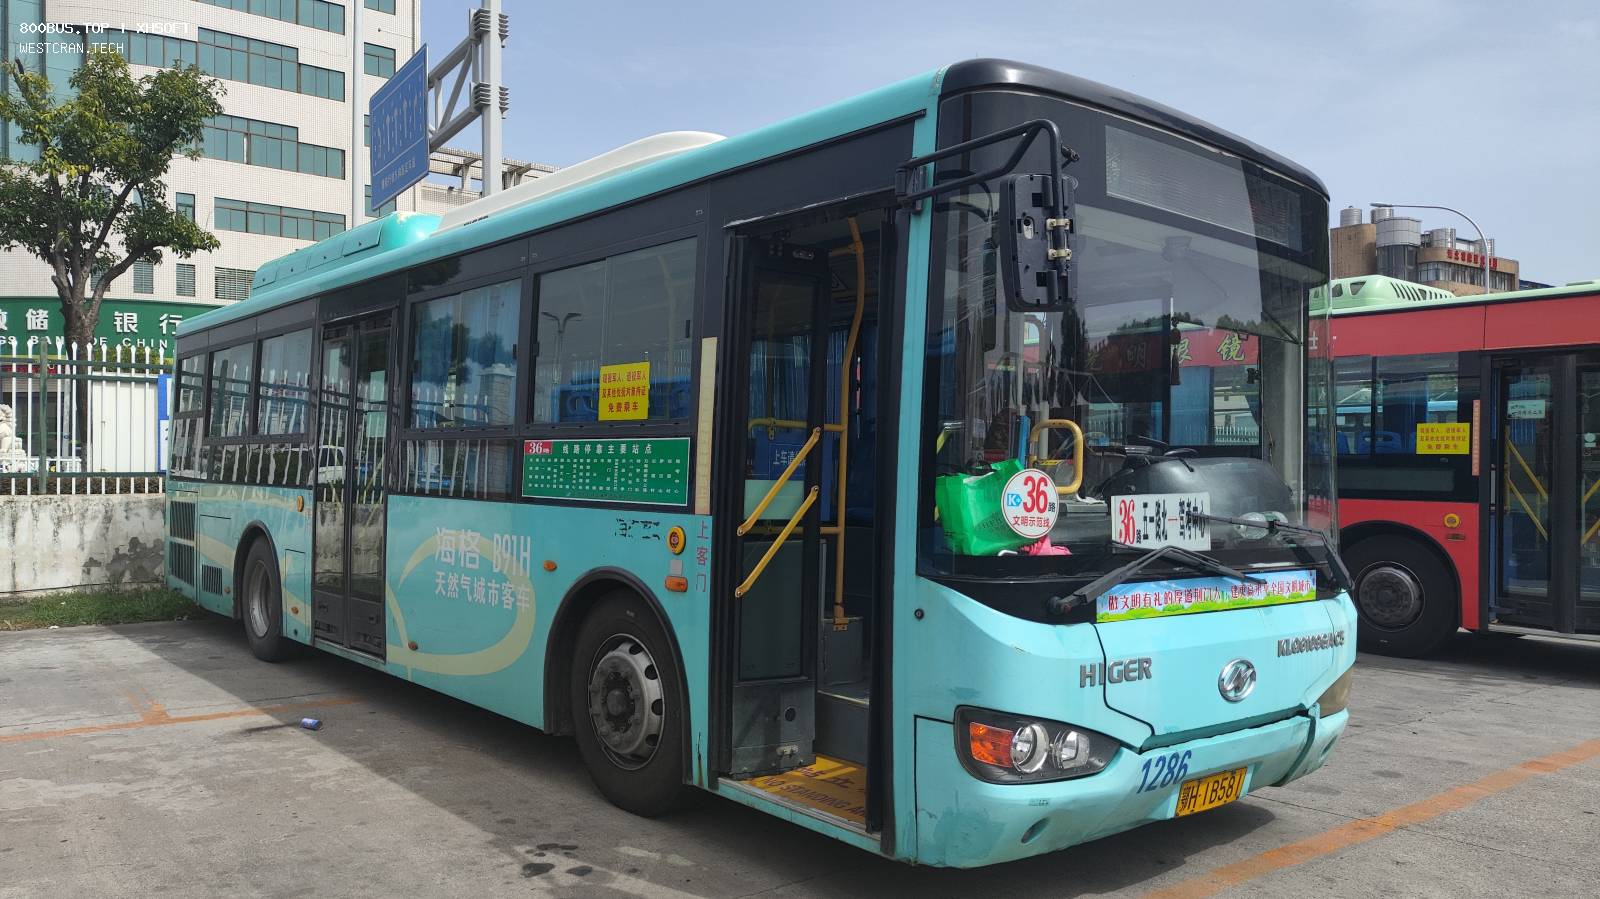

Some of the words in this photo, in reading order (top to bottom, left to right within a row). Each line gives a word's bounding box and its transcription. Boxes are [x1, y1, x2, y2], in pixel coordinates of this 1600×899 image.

[562, 443, 653, 456] 线路停靠主要站点
[1012, 515, 1051, 529] 文明示范线
[435, 526, 481, 570] 海格
[492, 532, 531, 578] B91H
[695, 519, 709, 592] 上客门
[435, 570, 530, 613] 天然气城市客车
[1079, 656, 1152, 689] HIGER
[1137, 749, 1192, 794] 1286
